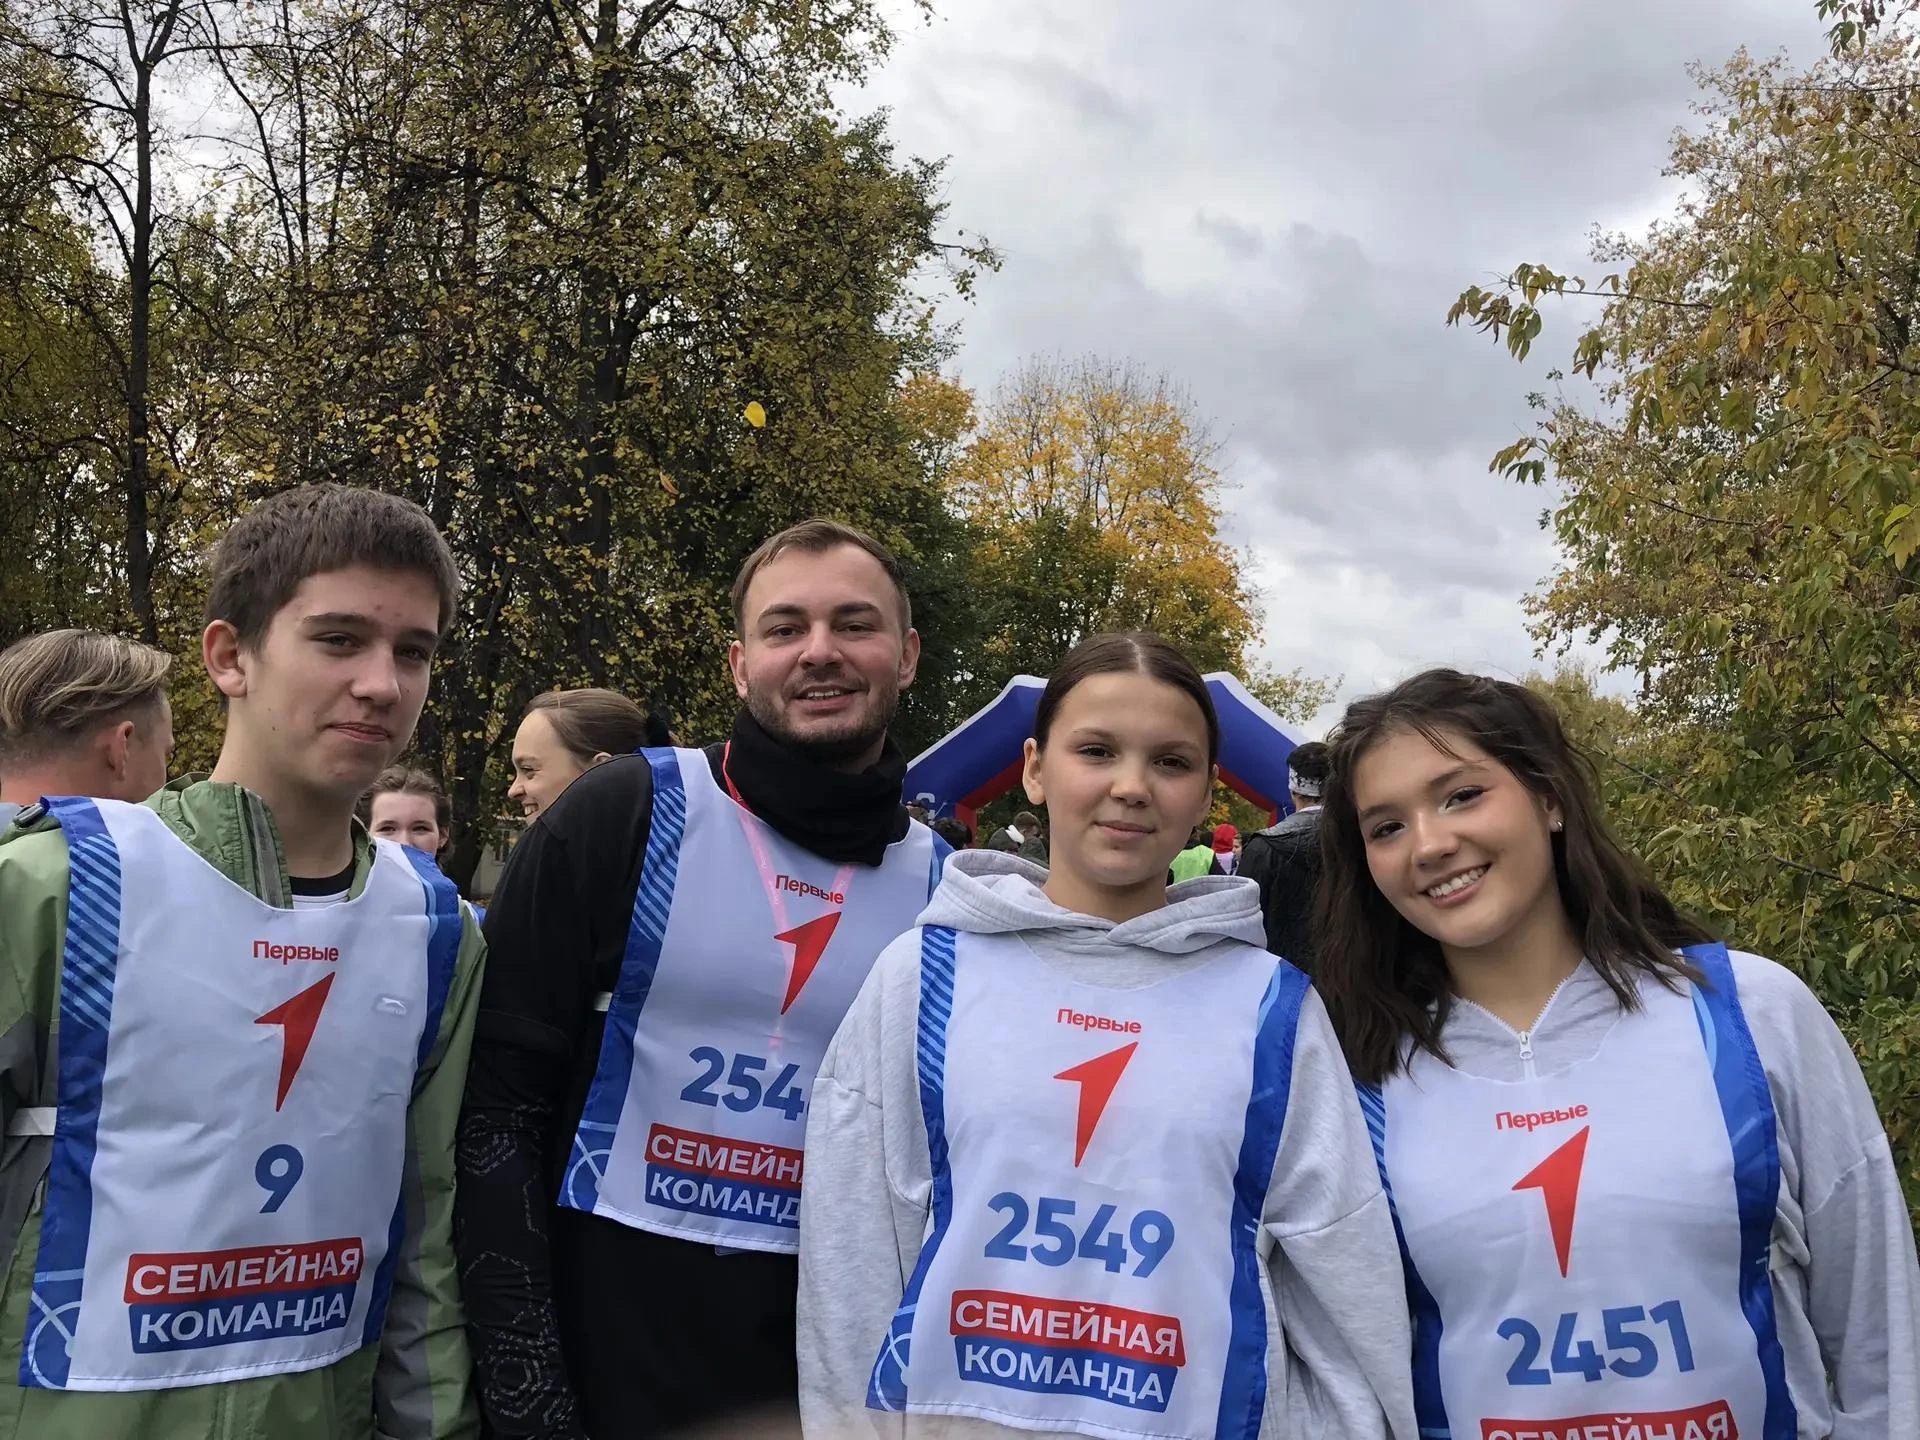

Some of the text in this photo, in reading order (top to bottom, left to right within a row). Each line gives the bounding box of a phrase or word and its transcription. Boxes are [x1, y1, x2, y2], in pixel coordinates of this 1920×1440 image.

[775, 874, 844, 904] Первые
[253, 941, 339, 965] Первые
[1057, 1008, 1142, 1034] Первые
[680, 1046, 809, 1121] 254
[1496, 1103, 1589, 1132] Первые
[254, 1143, 304, 1214] 9
[651, 1133, 803, 1184] СЕМЕЙН
[650, 1172, 801, 1226] КОМАНД
[984, 1192, 1175, 1278] 2549
[132, 1248, 361, 1296] СЕМЕЙНАЯ
[139, 1293, 347, 1344] КОМАНДА
[955, 1299, 1178, 1357] СЕМЕЙНАЯ
[1496, 1300, 1695, 1386] 2451
[964, 1344, 1165, 1404] КОМАНДА
